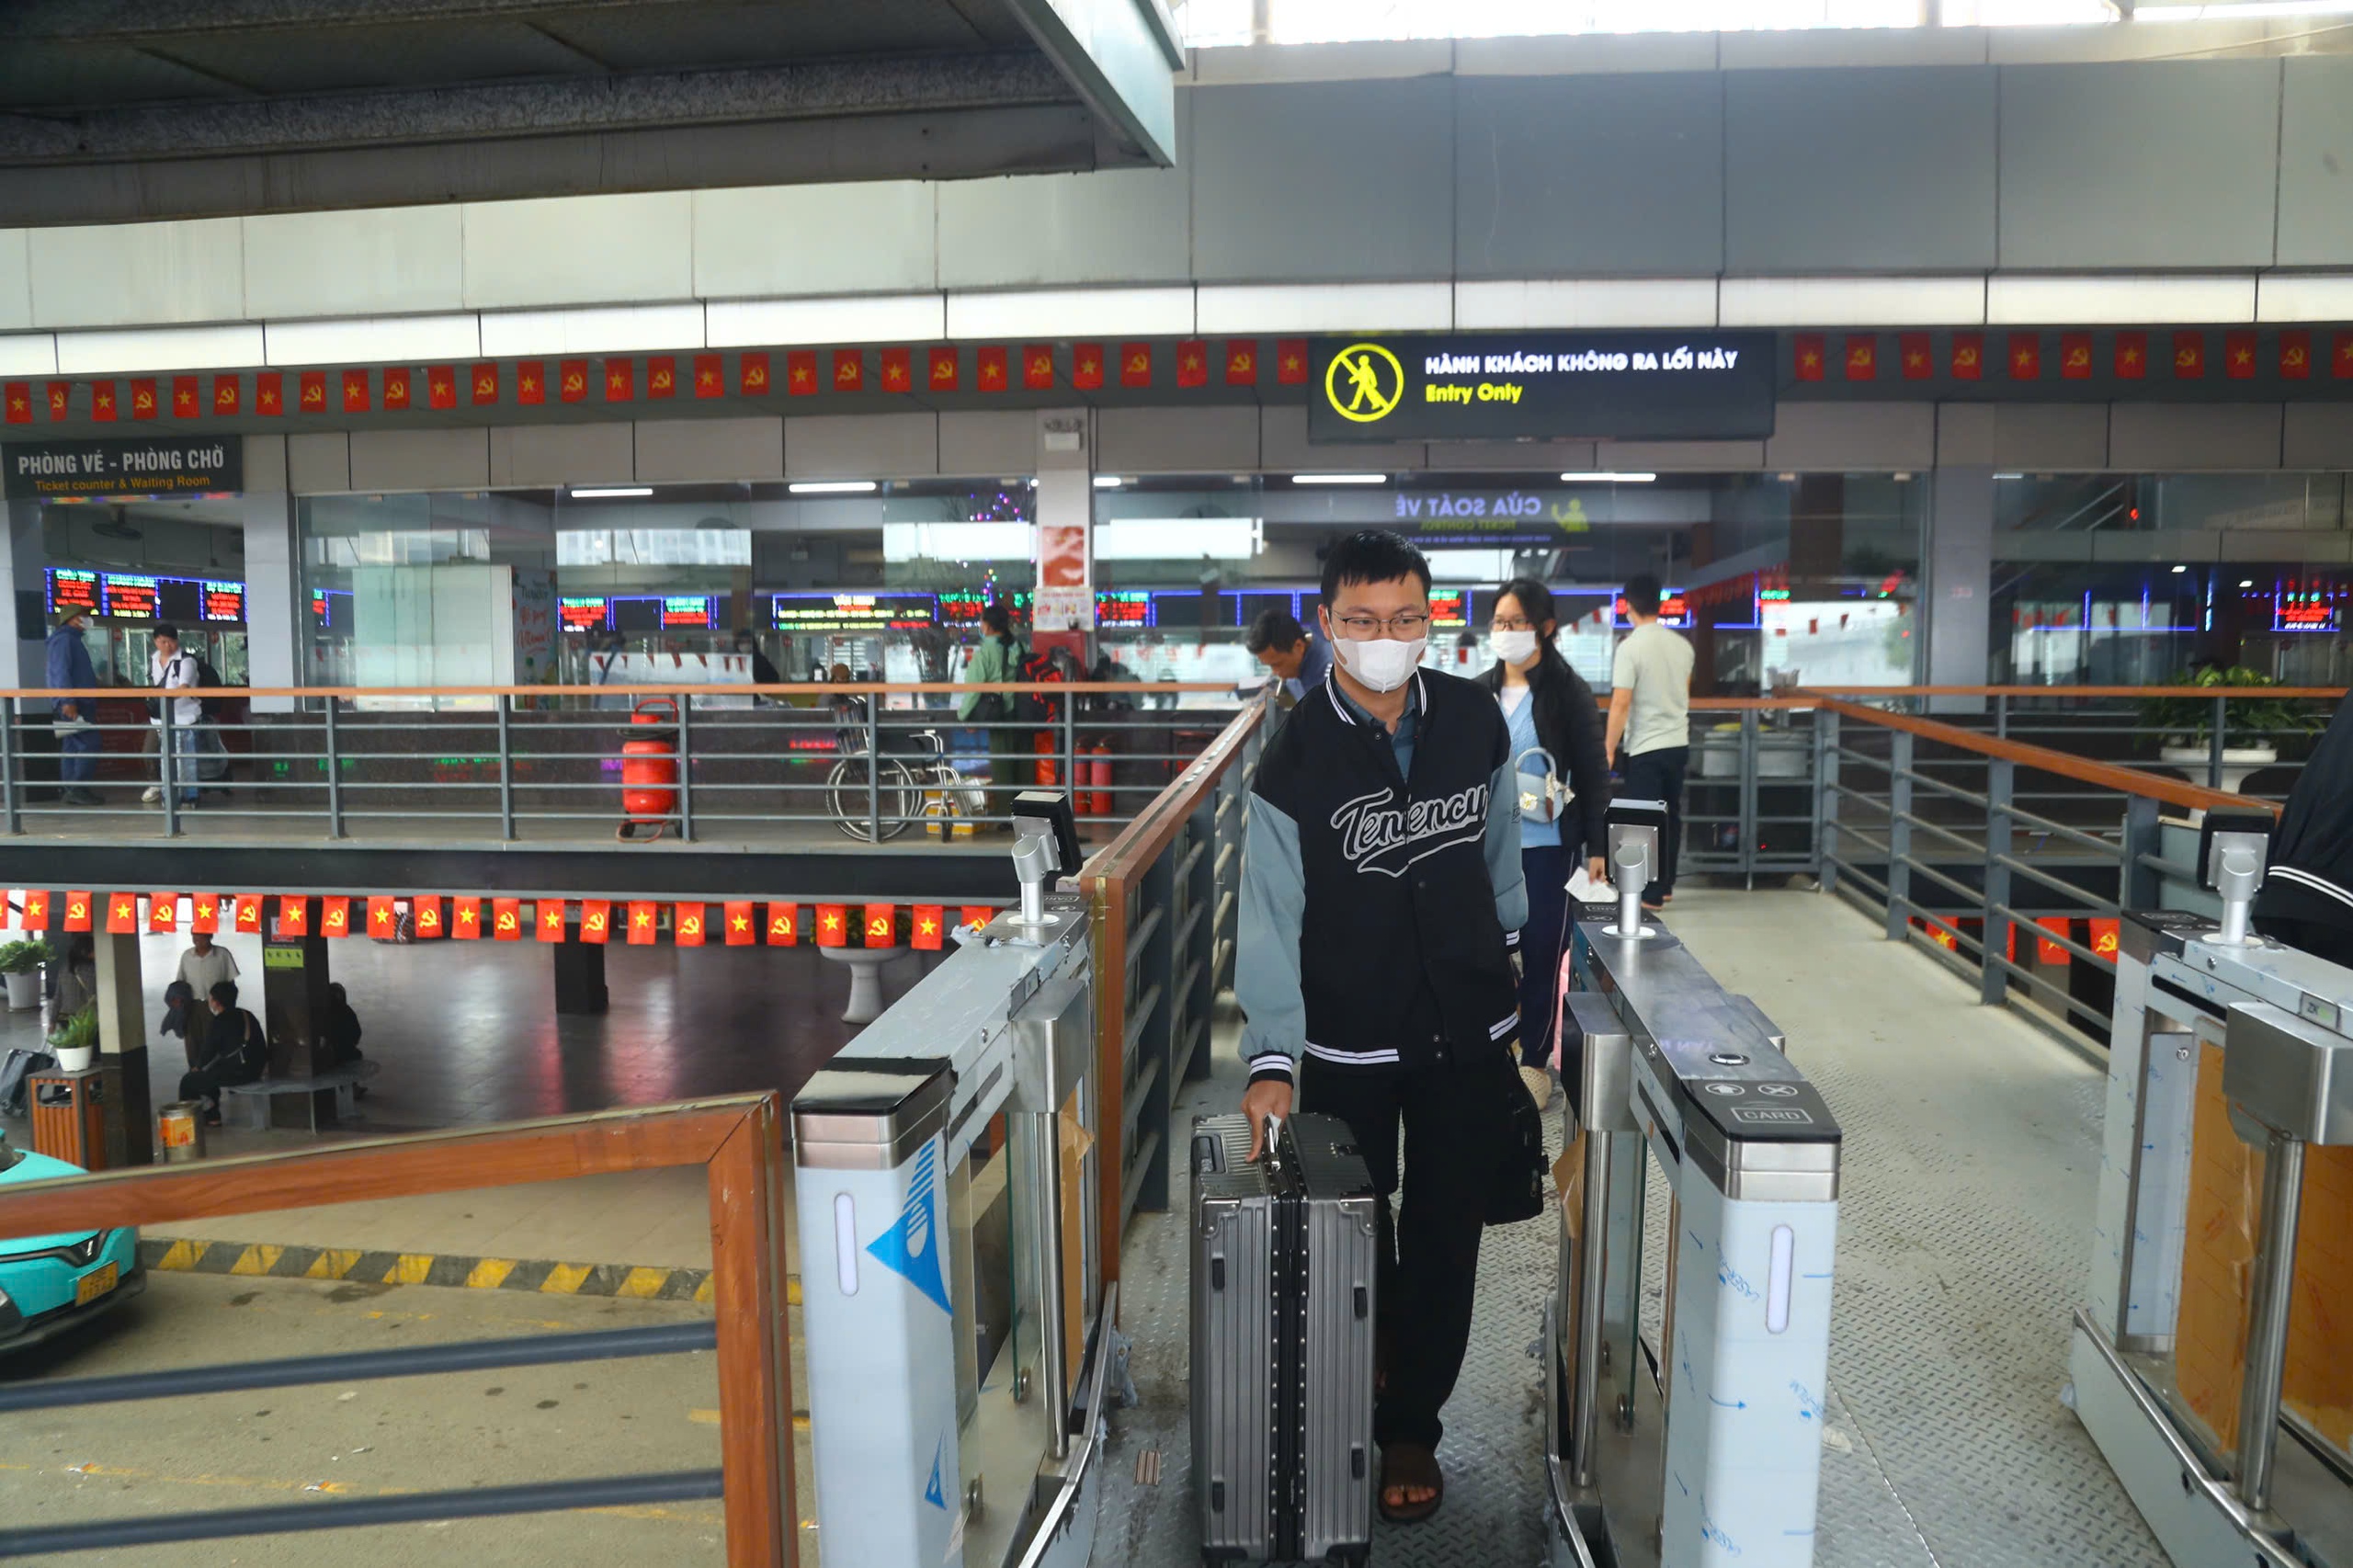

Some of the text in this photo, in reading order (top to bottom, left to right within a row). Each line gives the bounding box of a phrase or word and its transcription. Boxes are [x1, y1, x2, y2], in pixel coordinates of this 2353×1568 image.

[1425, 346, 1739, 375] HÀNH KHÁCH KHÔNG RA LỐI NÀY
[1426, 381, 1523, 404] Entry Only
[17, 450, 78, 475] PHÒNG
[83, 449, 105, 472] VÉ
[122, 446, 182, 472] PHÒNG
[188, 444, 224, 470] CHỜ
[35, 474, 210, 492] Ticket counter & Waiting Room
[1744, 1110, 1801, 1120] CARD
